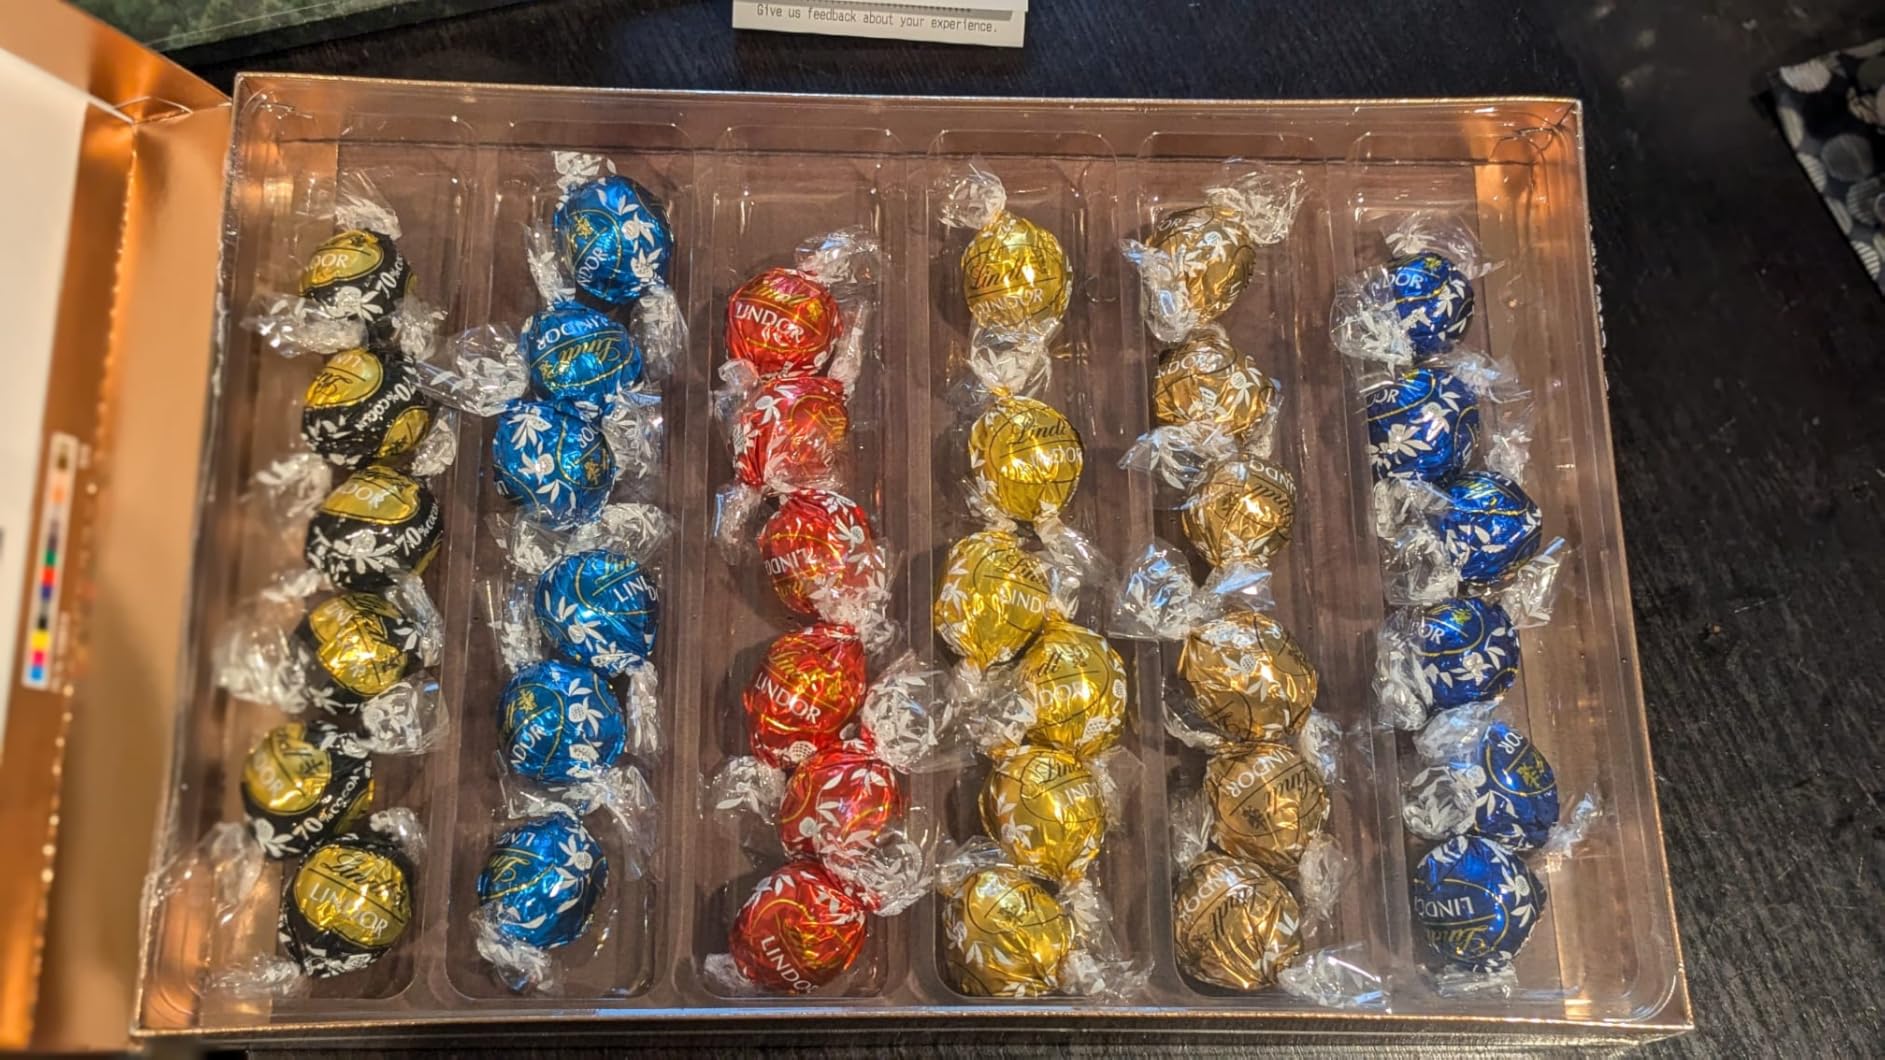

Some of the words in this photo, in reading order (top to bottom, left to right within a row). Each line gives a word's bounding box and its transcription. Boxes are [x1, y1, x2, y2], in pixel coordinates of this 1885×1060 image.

[757, 3, 782, 17] Give
[788, 8, 801, 19] us
[808, 7, 857, 23] feedback
[863, 10, 893, 25] about
[900, 16, 925, 28] your
[931, 18, 997, 33] experience.
[576, 246, 609, 286] NDOR
[765, 548, 808, 577] LINDO
[755, 672, 821, 724] LINDOR
[1414, 896, 1475, 918] LINDO
